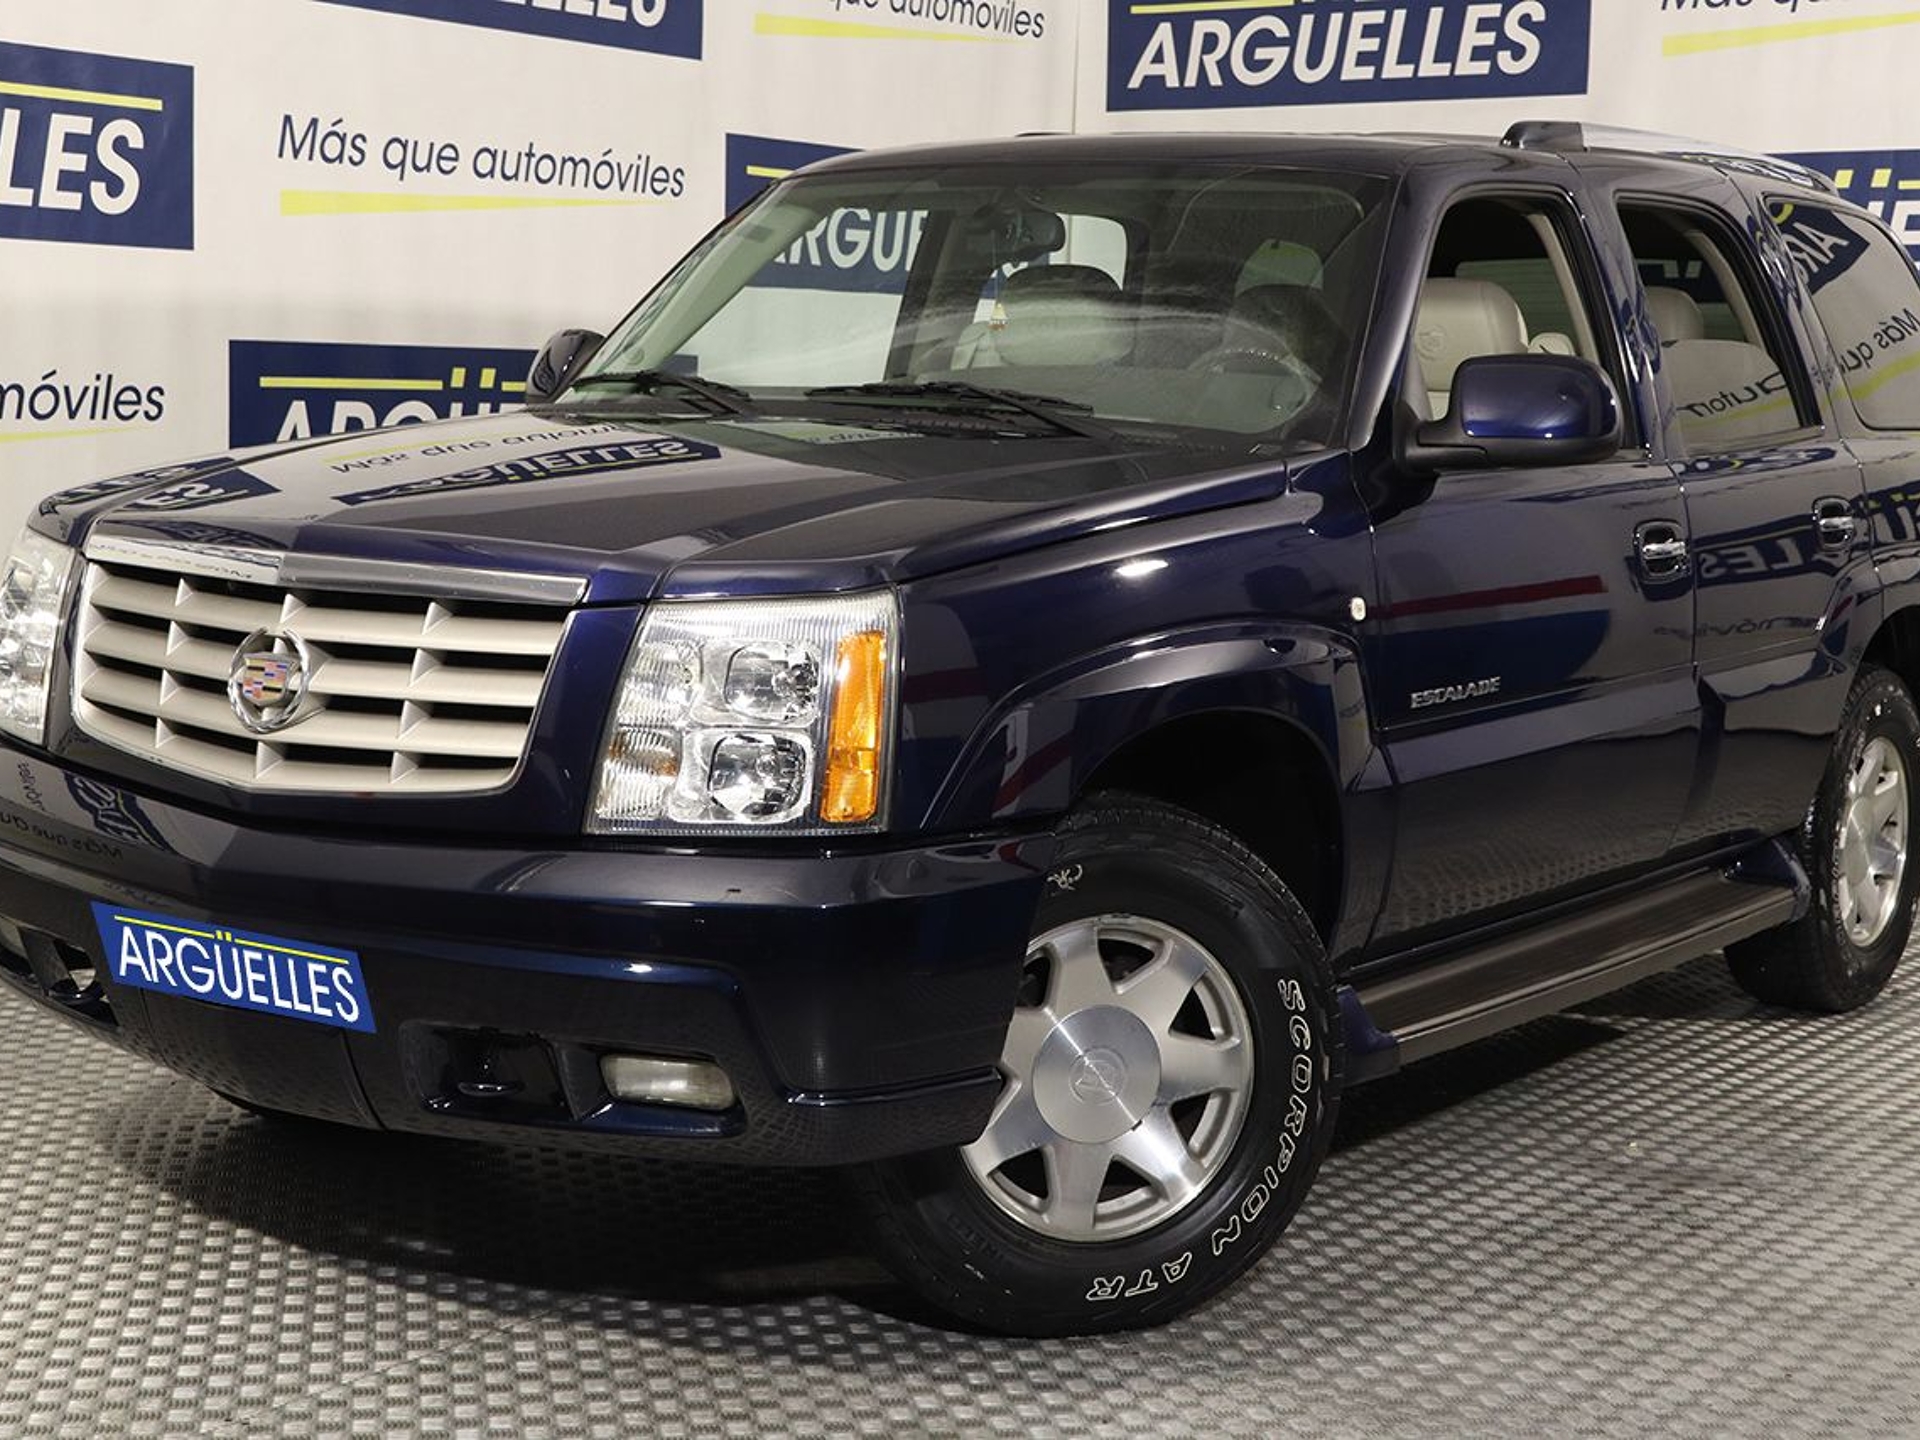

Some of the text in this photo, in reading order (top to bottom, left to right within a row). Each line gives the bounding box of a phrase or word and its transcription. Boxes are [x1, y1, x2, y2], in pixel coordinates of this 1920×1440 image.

[278, 114, 686, 197] Más que automóviles
[1410, 676, 1501, 709] ESCALADE
[1086, 978, 1313, 1300] SCORPION ATR
